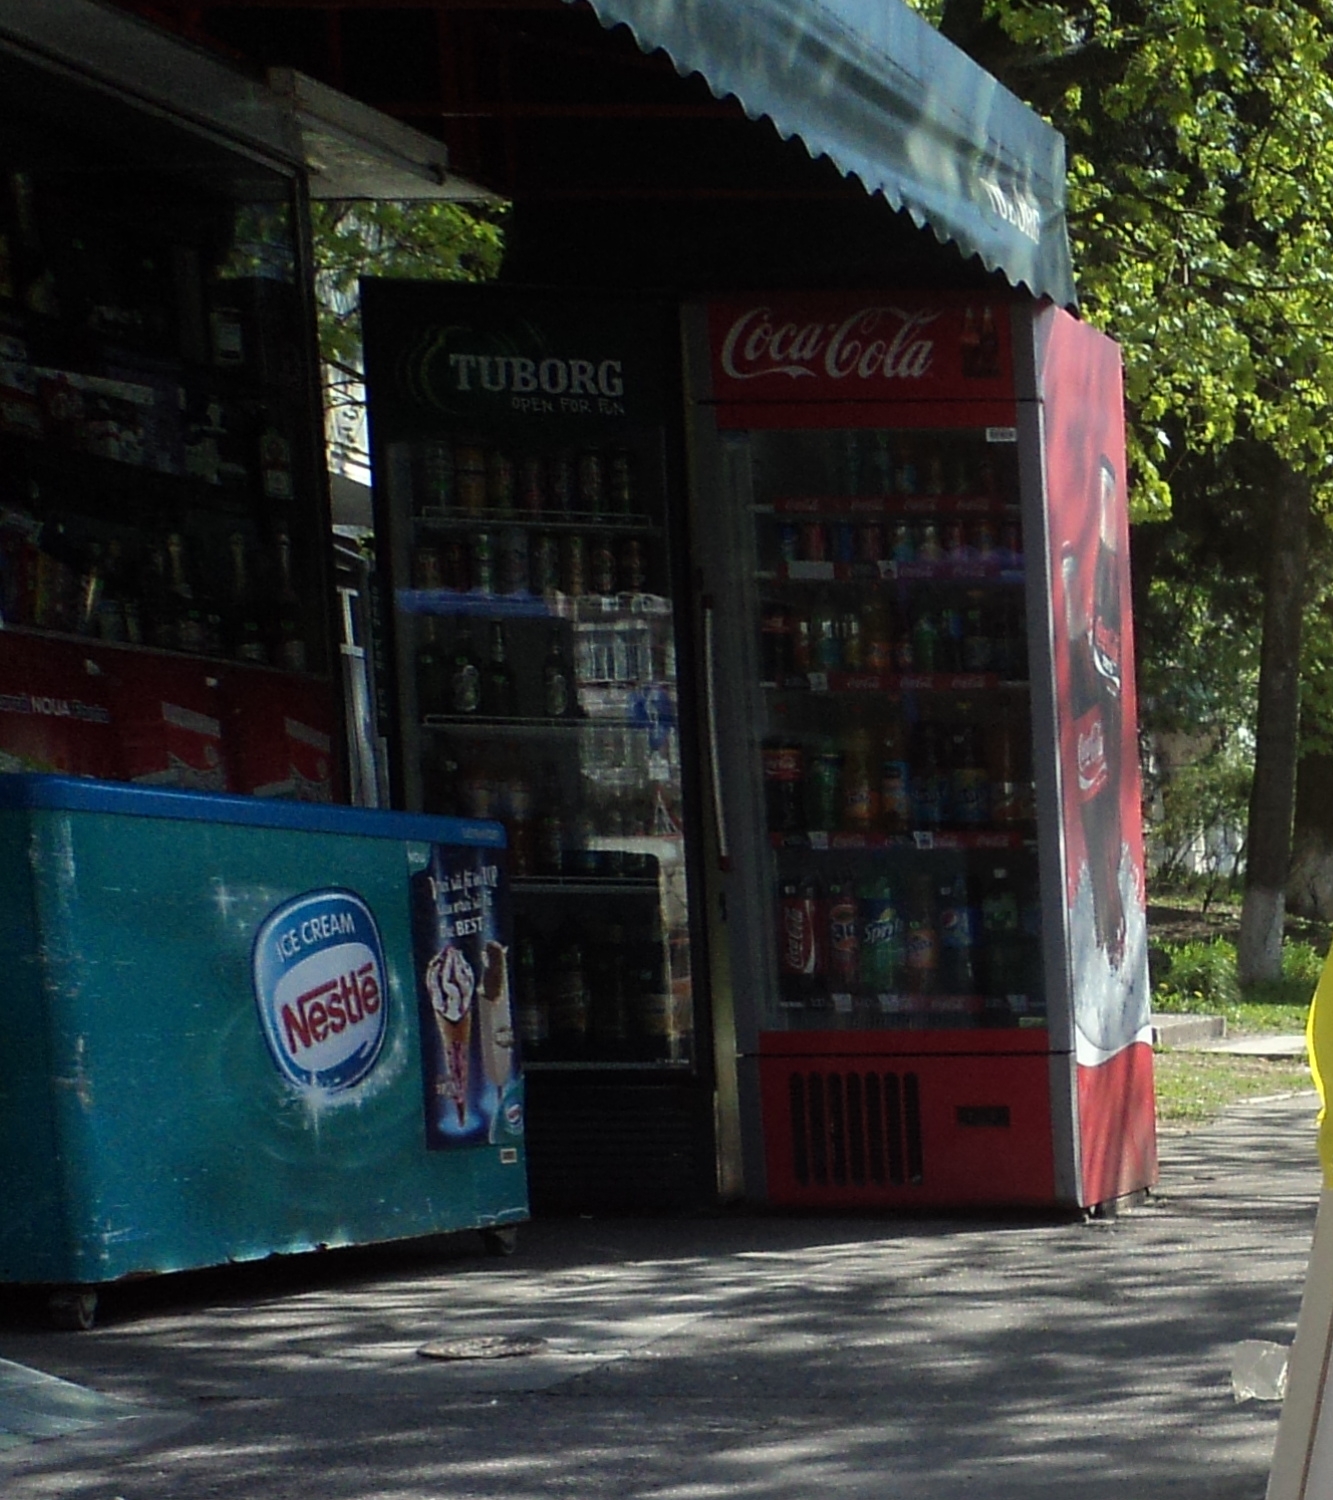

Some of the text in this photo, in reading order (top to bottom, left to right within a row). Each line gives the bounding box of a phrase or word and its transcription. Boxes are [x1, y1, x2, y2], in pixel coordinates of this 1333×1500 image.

[721, 306, 944, 380] Coca-Cola
[449, 353, 625, 397] TUBORG
[512, 397, 625, 416] OPEN FOR FUN
[276, 913, 356, 962] ICE CREAM
[455, 916, 483, 937] BEST
